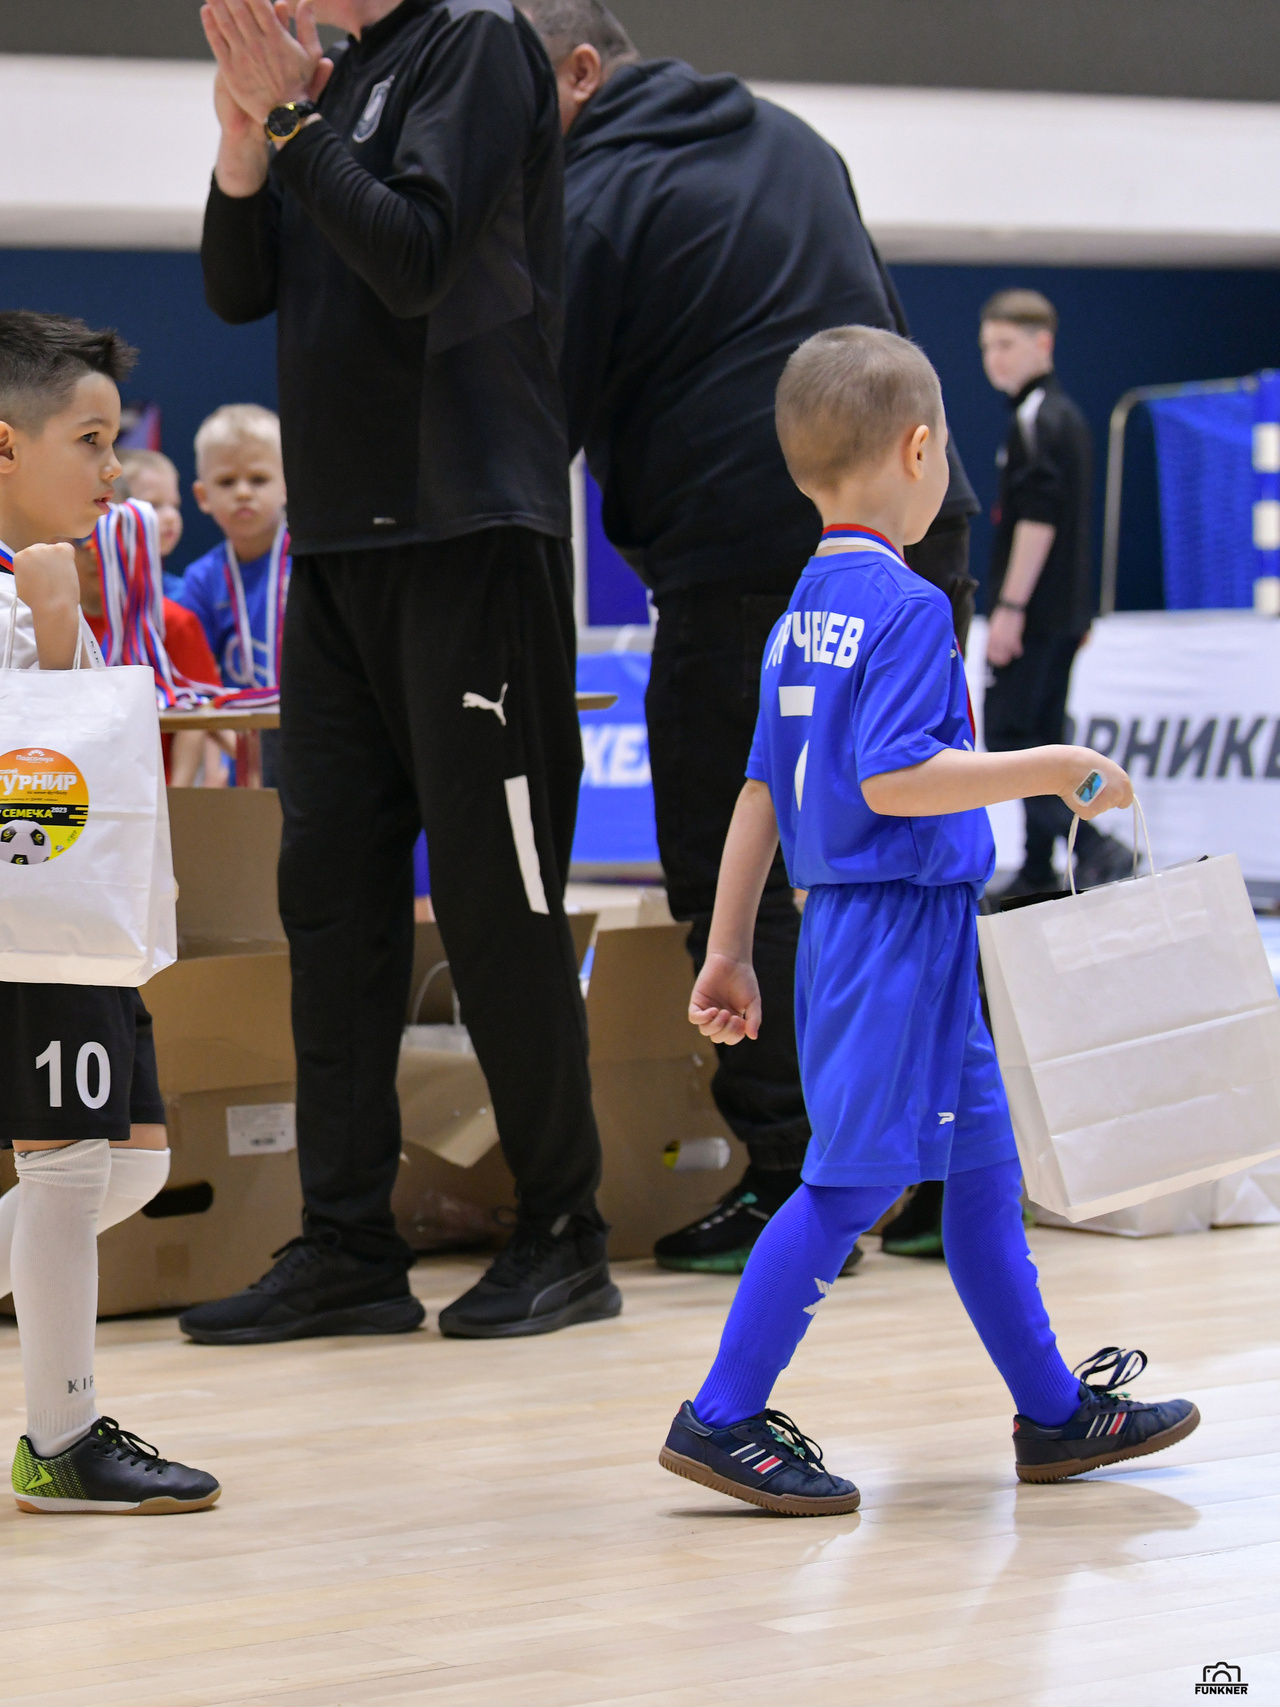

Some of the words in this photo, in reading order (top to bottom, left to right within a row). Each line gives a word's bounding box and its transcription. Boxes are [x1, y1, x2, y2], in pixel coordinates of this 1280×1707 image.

[1064, 716, 1280, 778] РНИК
[2, 808, 53, 819] СЕМЕЧКА
[51, 806, 68, 814] 2023
[35, 1040, 112, 1110] 10
